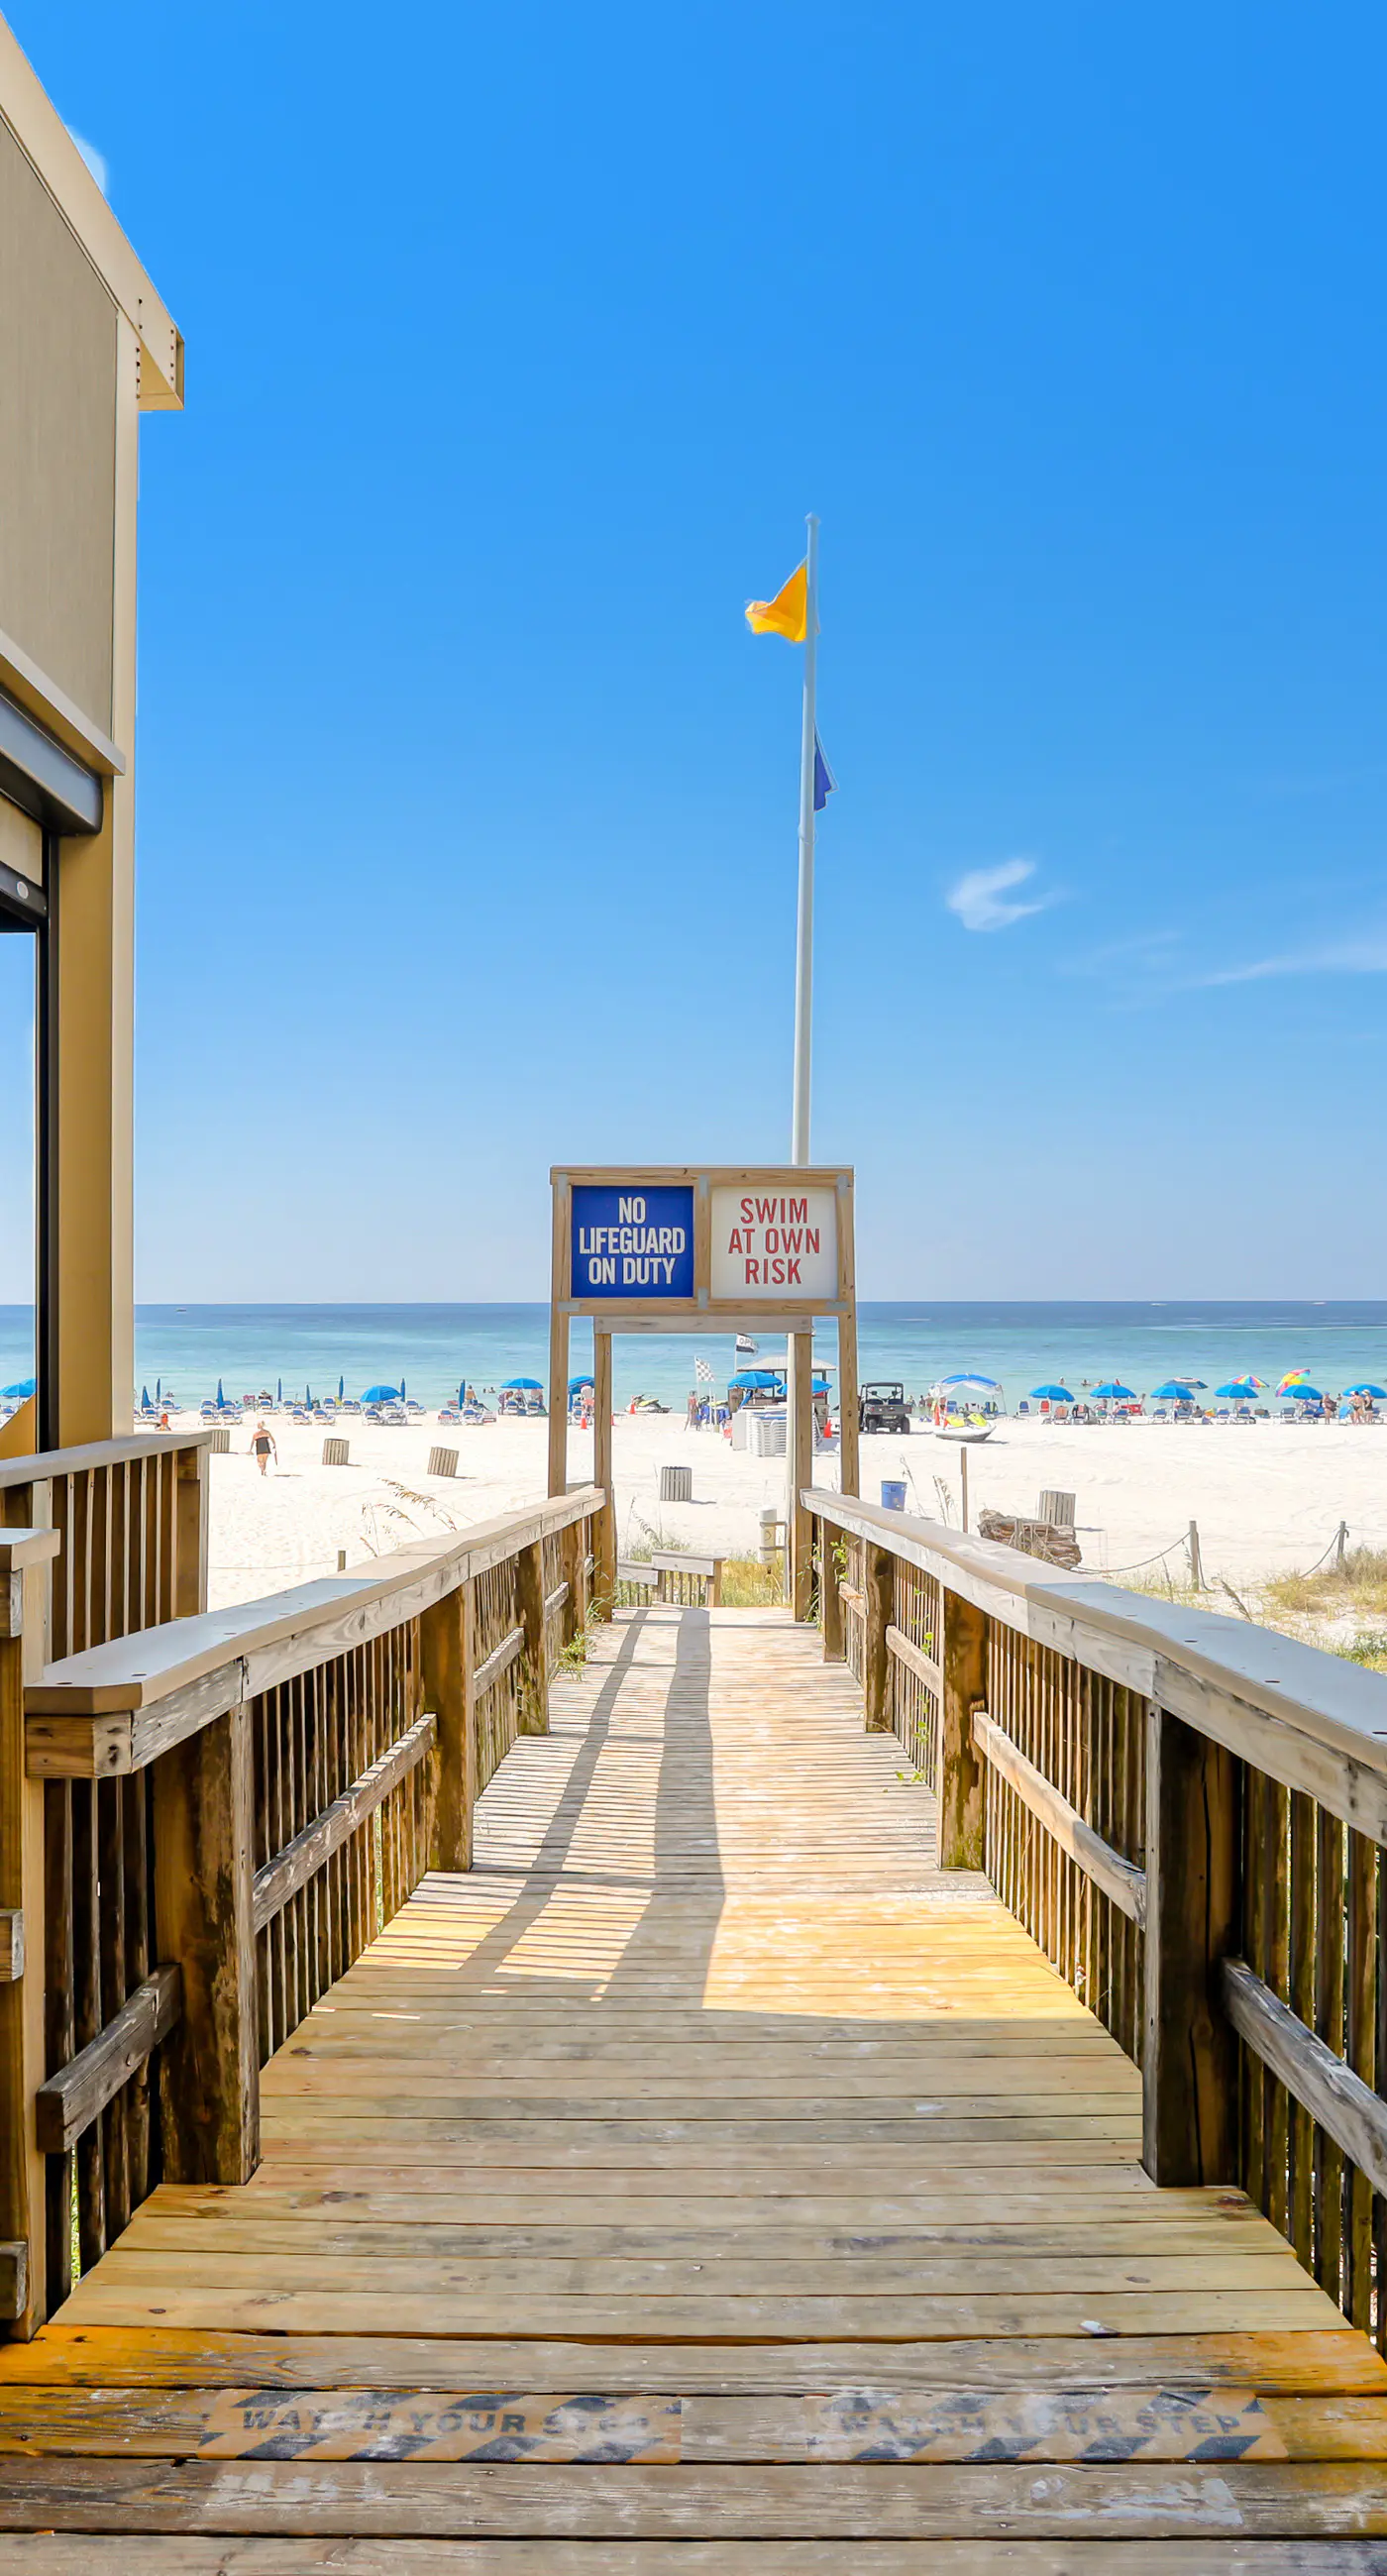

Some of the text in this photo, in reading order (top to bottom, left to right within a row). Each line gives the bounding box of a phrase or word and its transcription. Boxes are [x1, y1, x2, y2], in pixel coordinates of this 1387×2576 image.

[618, 1196, 646, 1225] NO
[740, 1197, 808, 1225] SWIM
[579, 1227, 686, 1254] LIFEGUARD
[727, 1228, 820, 1254] AT OWN
[587, 1257, 676, 1285] ON DUTY
[745, 1258, 802, 1285] RISK
[409, 2412, 527, 2433] YOUR
[1135, 2414, 1240, 2434] STEP
